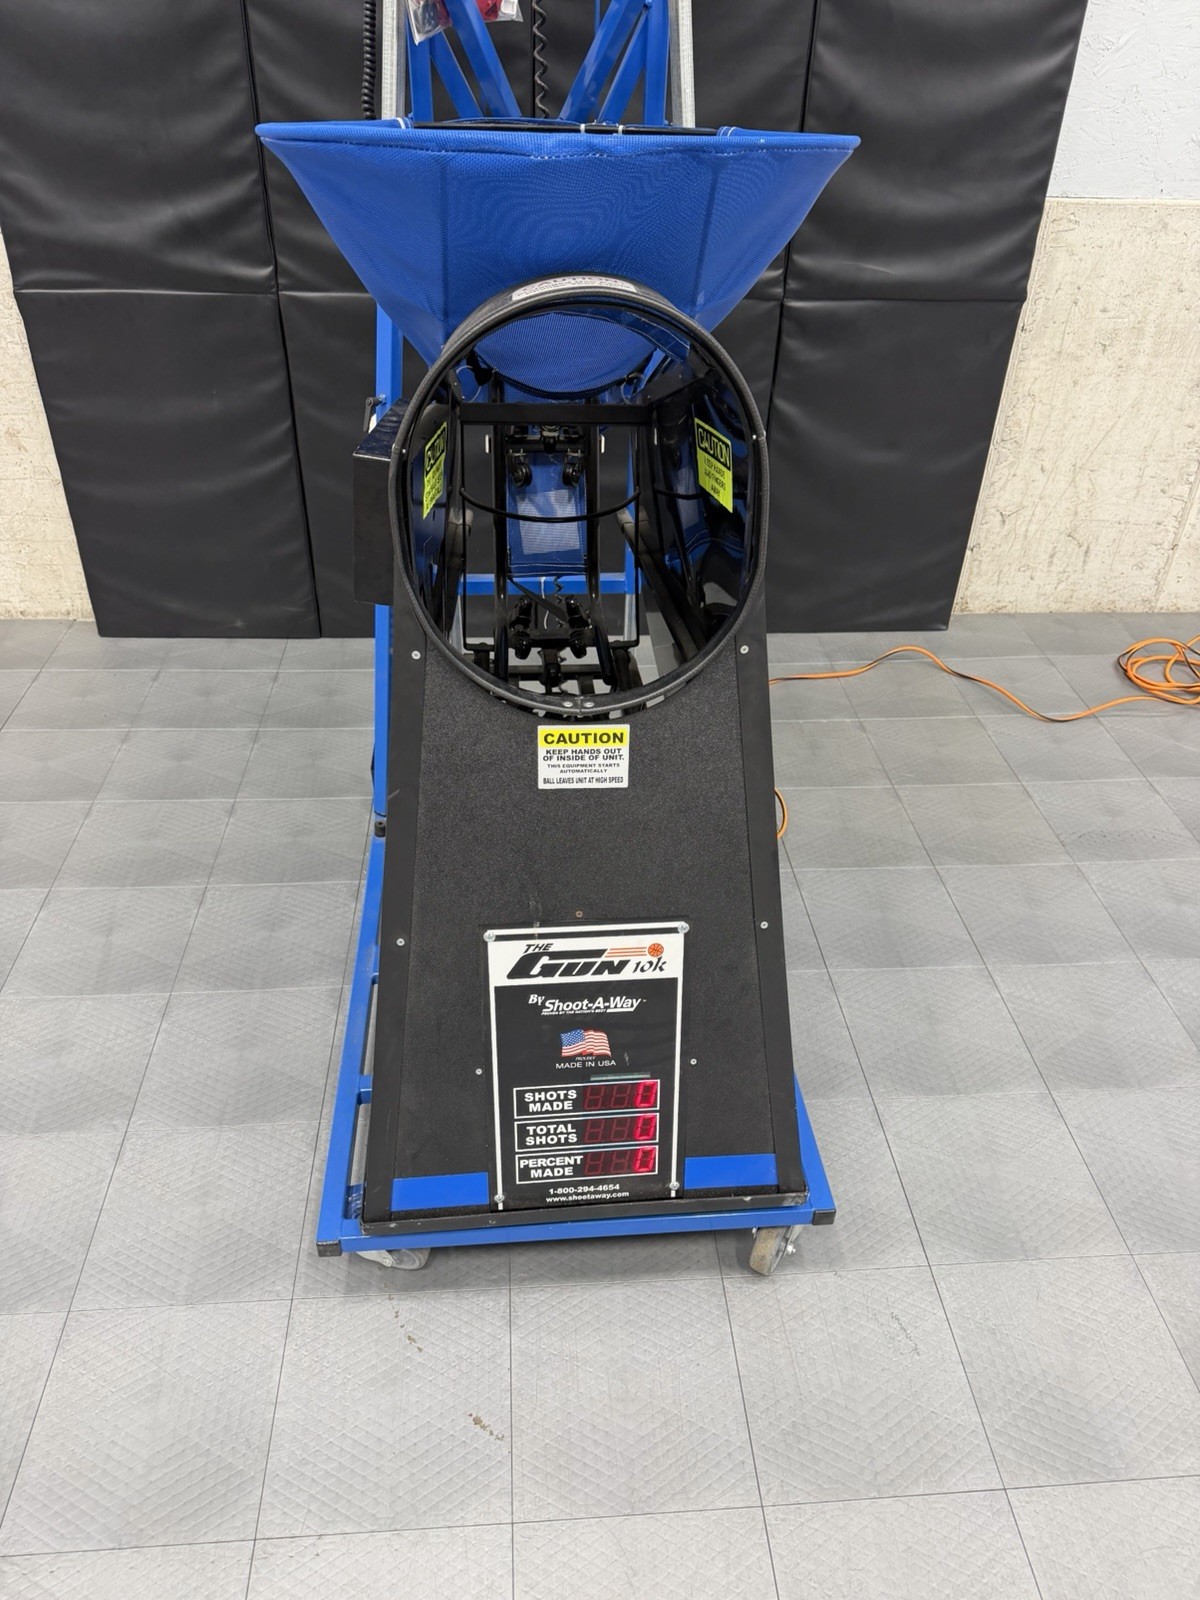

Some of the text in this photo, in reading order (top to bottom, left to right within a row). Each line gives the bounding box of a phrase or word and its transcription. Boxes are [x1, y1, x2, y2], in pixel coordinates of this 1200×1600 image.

[698, 428, 730, 467] CAUTION
[543, 732, 624, 744] CAUTION
[523, 943, 553, 953] THE
[506, 948, 632, 980] GUN
[542, 995, 642, 1012] Shoot-A-Way
[555, 1061, 583, 1069] MADE
[524, 1090, 577, 1102] SHOTS
[634, 1081, 657, 1107] 0
[528, 1100, 573, 1113] MADE
[526, 1123, 576, 1135] TOTAL
[633, 1114, 657, 1140] 0
[525, 1133, 578, 1146] SHOTS
[519, 1155, 584, 1168] PERCENT
[633, 1146, 657, 1173] 0
[530, 1167, 573, 1179] MADE
[548, 1183, 620, 1195] 1-800-294-4654
[545, 1191, 630, 1203] www.shootaway.com
